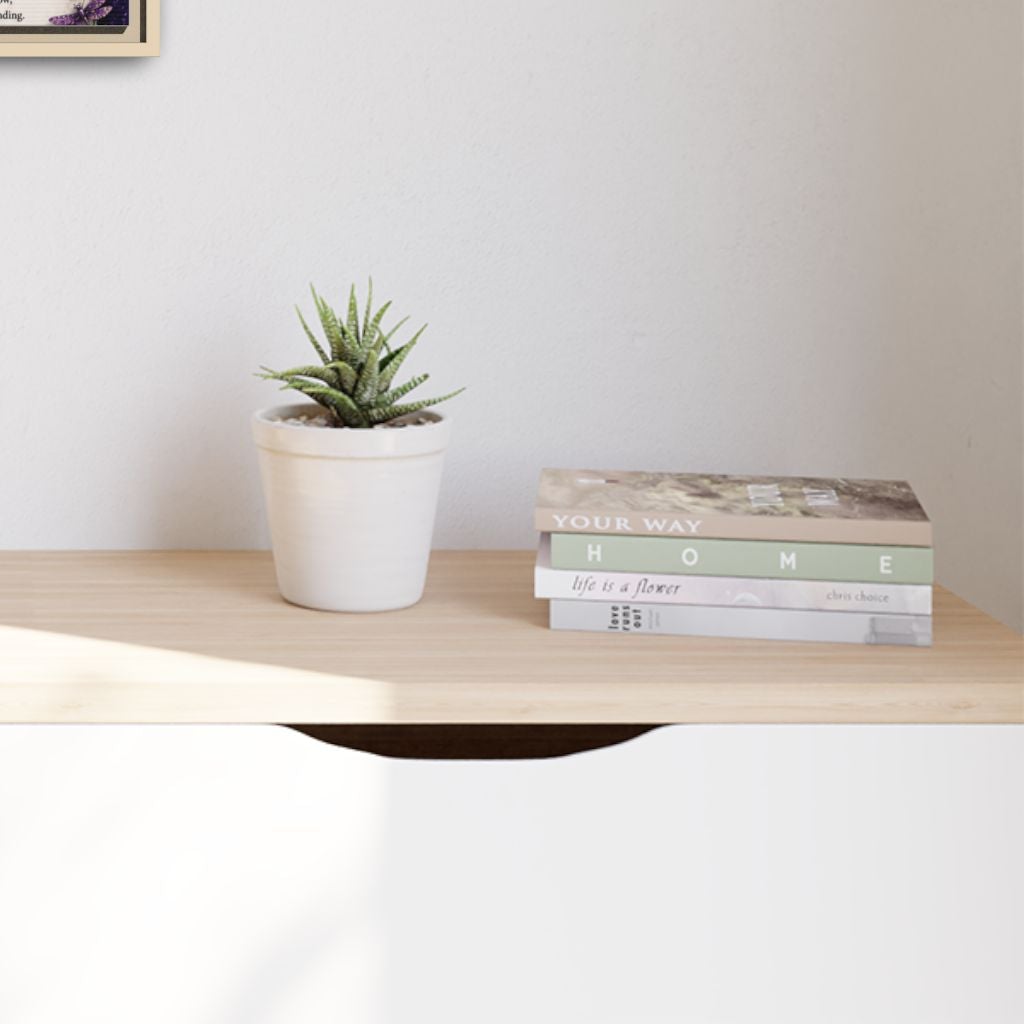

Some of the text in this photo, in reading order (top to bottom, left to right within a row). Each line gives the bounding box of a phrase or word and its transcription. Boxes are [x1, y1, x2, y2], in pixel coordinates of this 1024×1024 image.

[552, 513, 704, 533] YOUR WAY
[572, 575, 682, 599] life is a flower
[607, 605, 619, 630] love
[622, 605, 630, 631] runs
[632, 608, 641, 629] out
